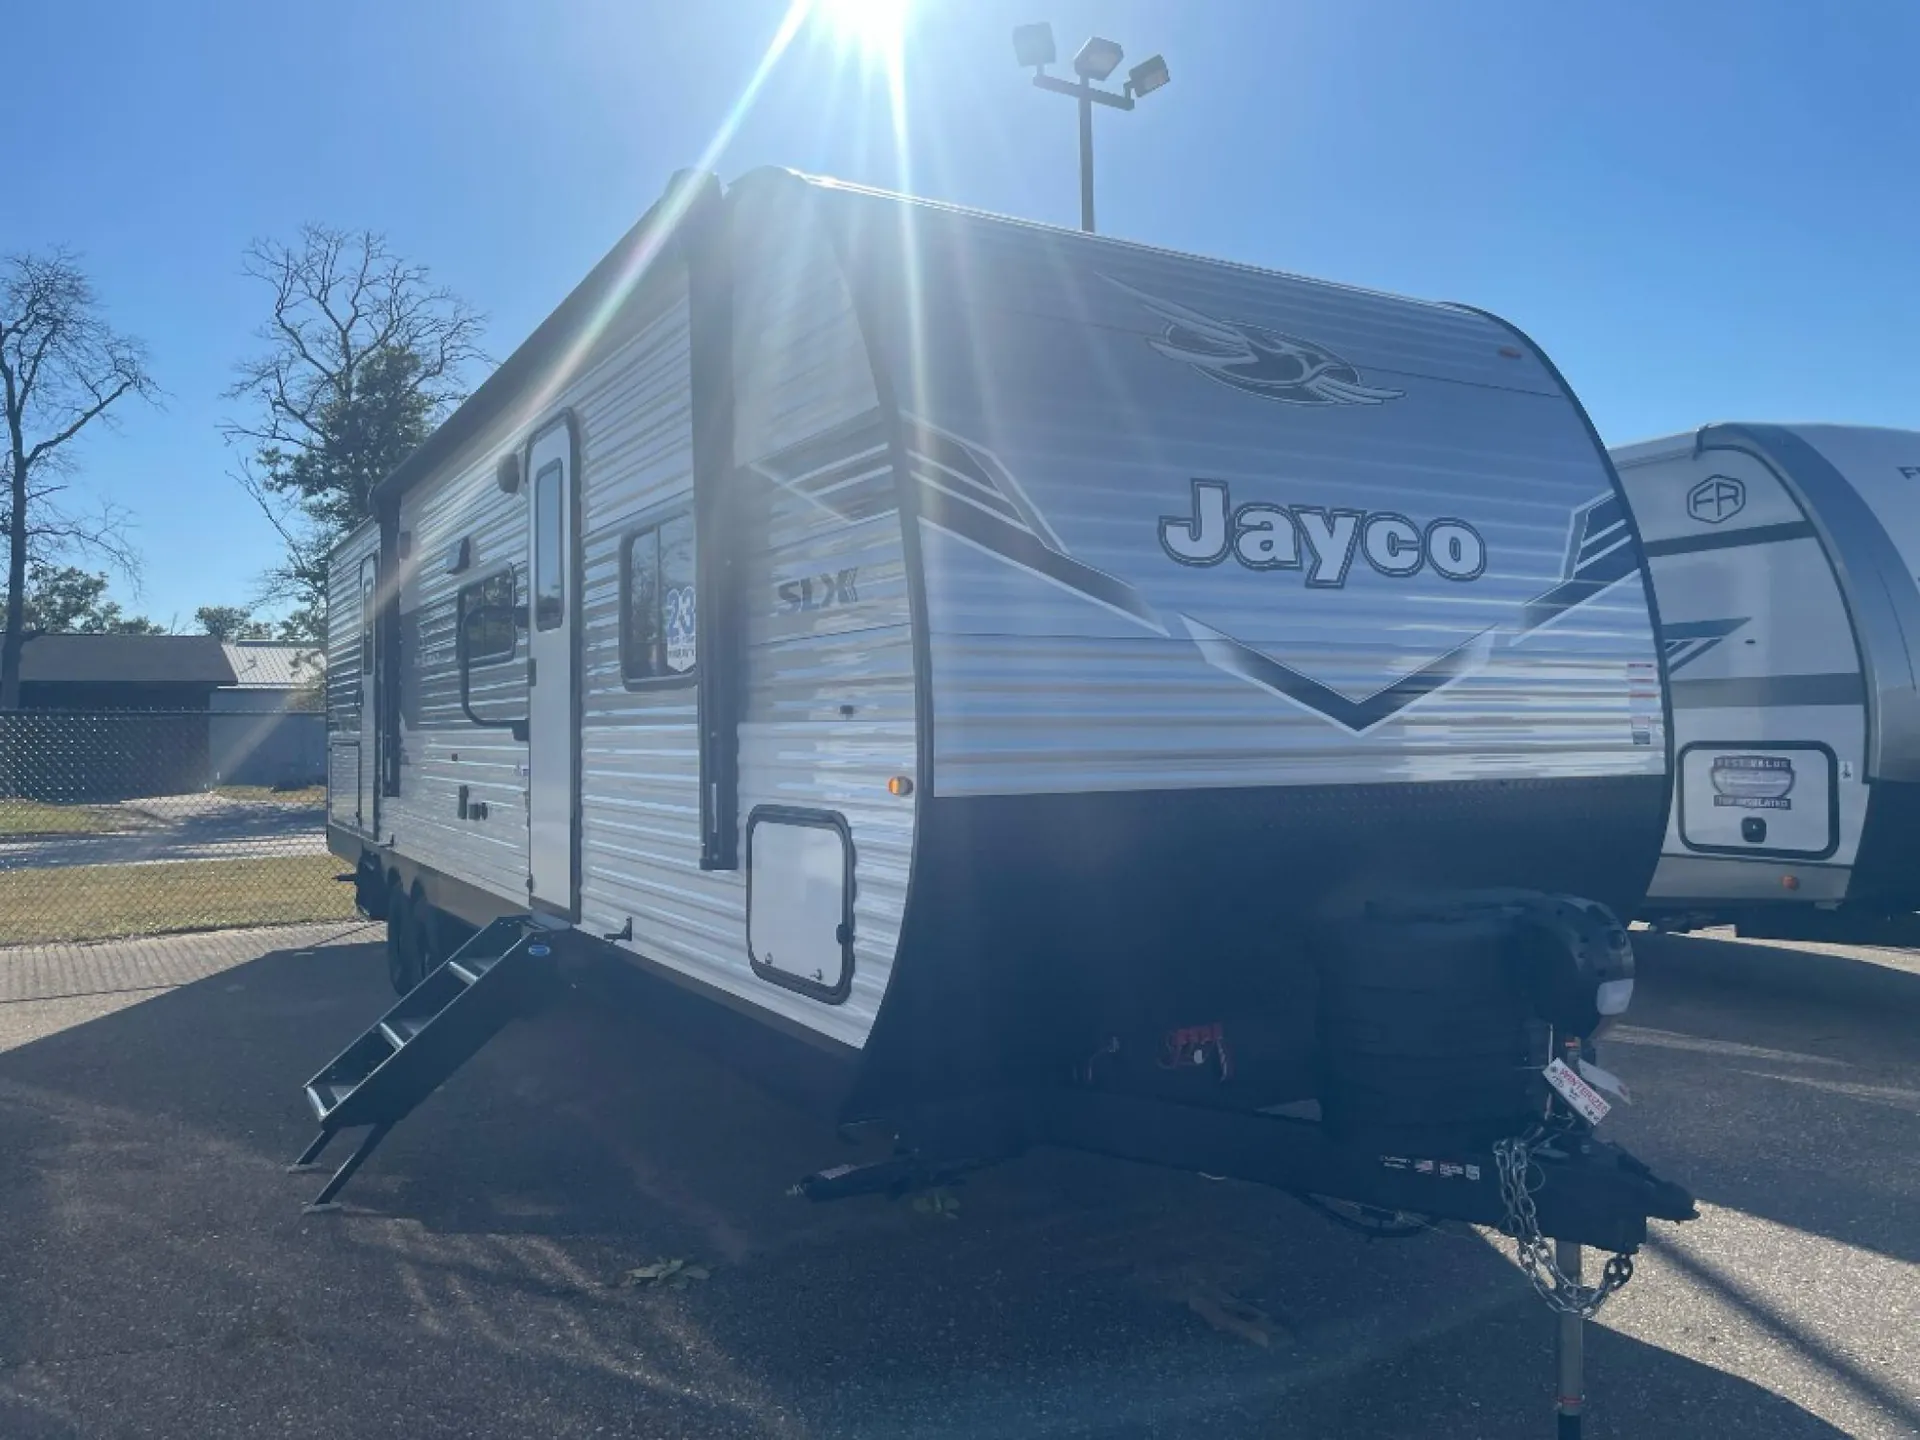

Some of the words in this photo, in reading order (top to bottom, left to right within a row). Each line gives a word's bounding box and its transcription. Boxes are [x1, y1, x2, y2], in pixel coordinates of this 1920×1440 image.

[1692, 481, 1740, 517] FR
[1158, 478, 1487, 588] Jayco
[777, 566, 859, 615] SLX
